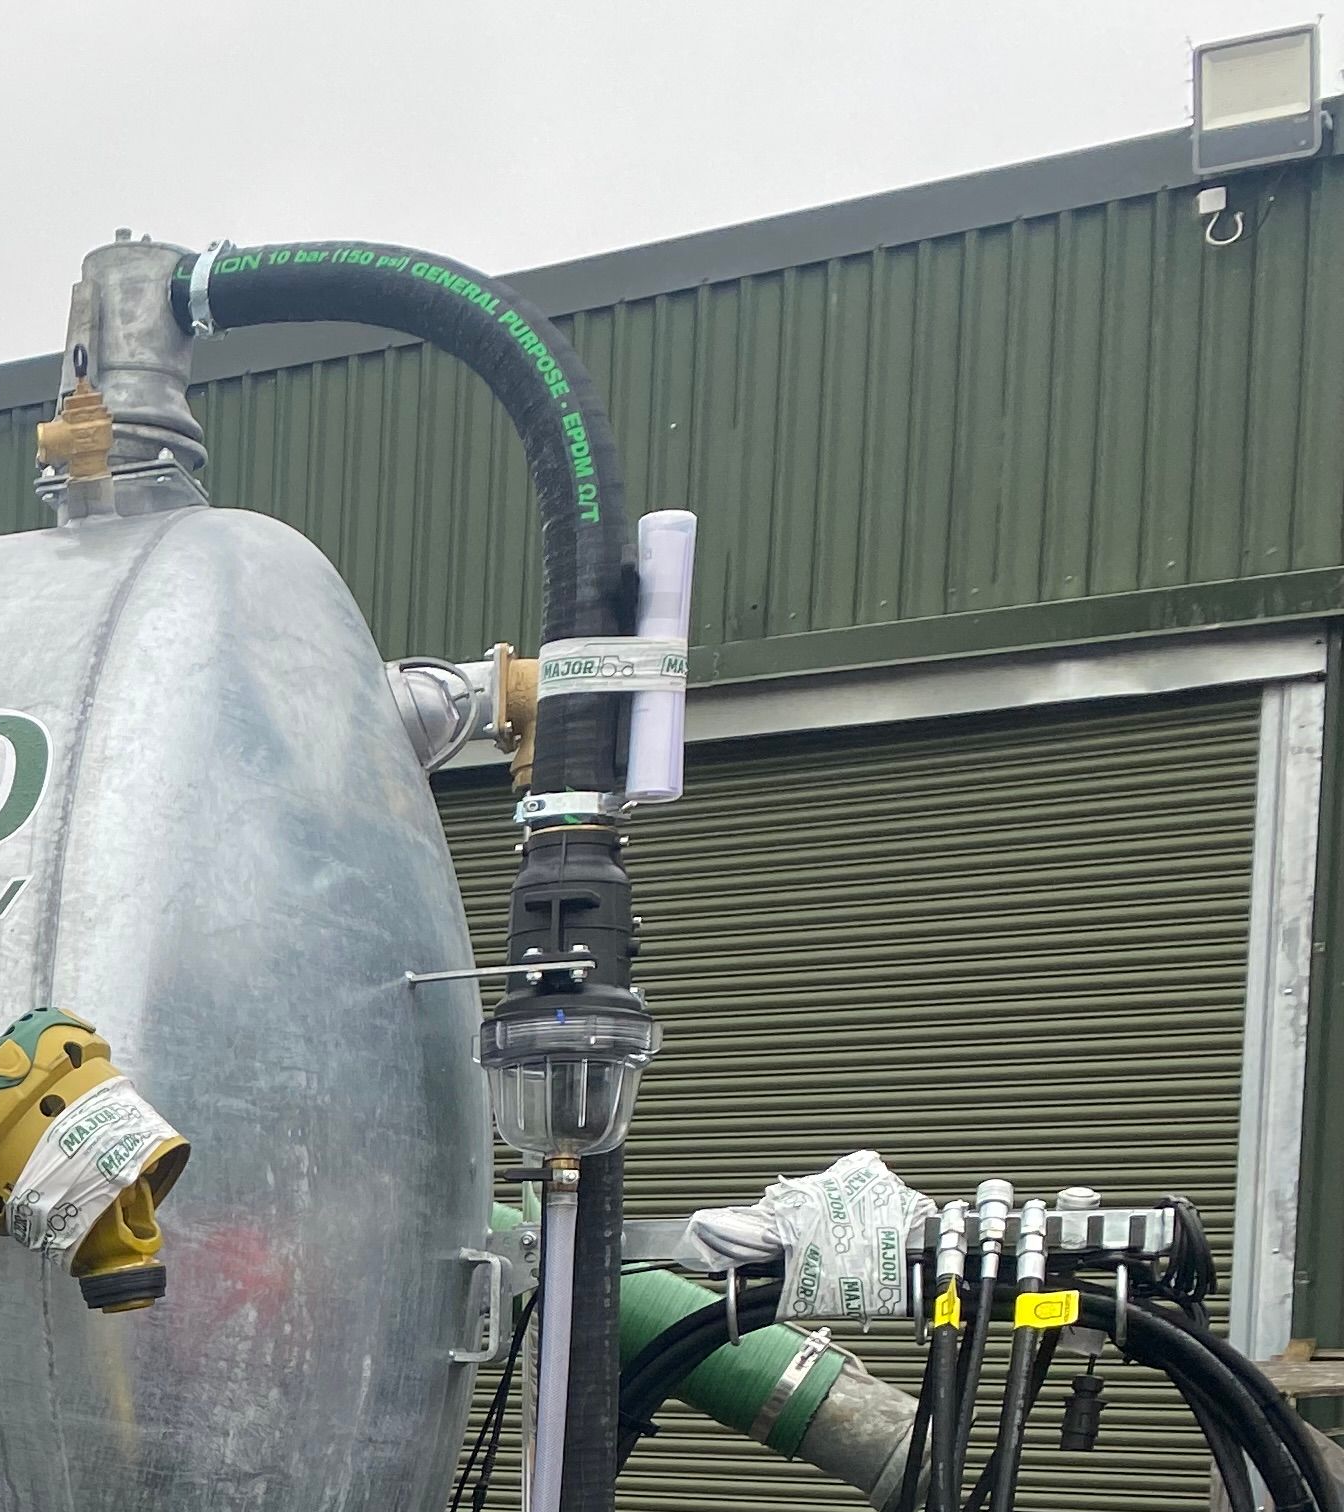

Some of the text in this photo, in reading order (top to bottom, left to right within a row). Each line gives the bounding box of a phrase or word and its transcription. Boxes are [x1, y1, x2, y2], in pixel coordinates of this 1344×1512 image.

[268, 249, 286, 265] 10
[293, 248, 329, 263] bar
[331, 248, 374, 266] (150
[375, 255, 410, 272] psi)
[411, 261, 501, 316] GENERAL
[498, 309, 570, 399] PURPOSE
[562, 411, 594, 478] EPDM
[543, 660, 593, 679] MAJOR
[822, 1178, 847, 1222] MAJOR
[799, 1248, 821, 1301] MAJOR
[880, 1229, 898, 1282] MAJOR
